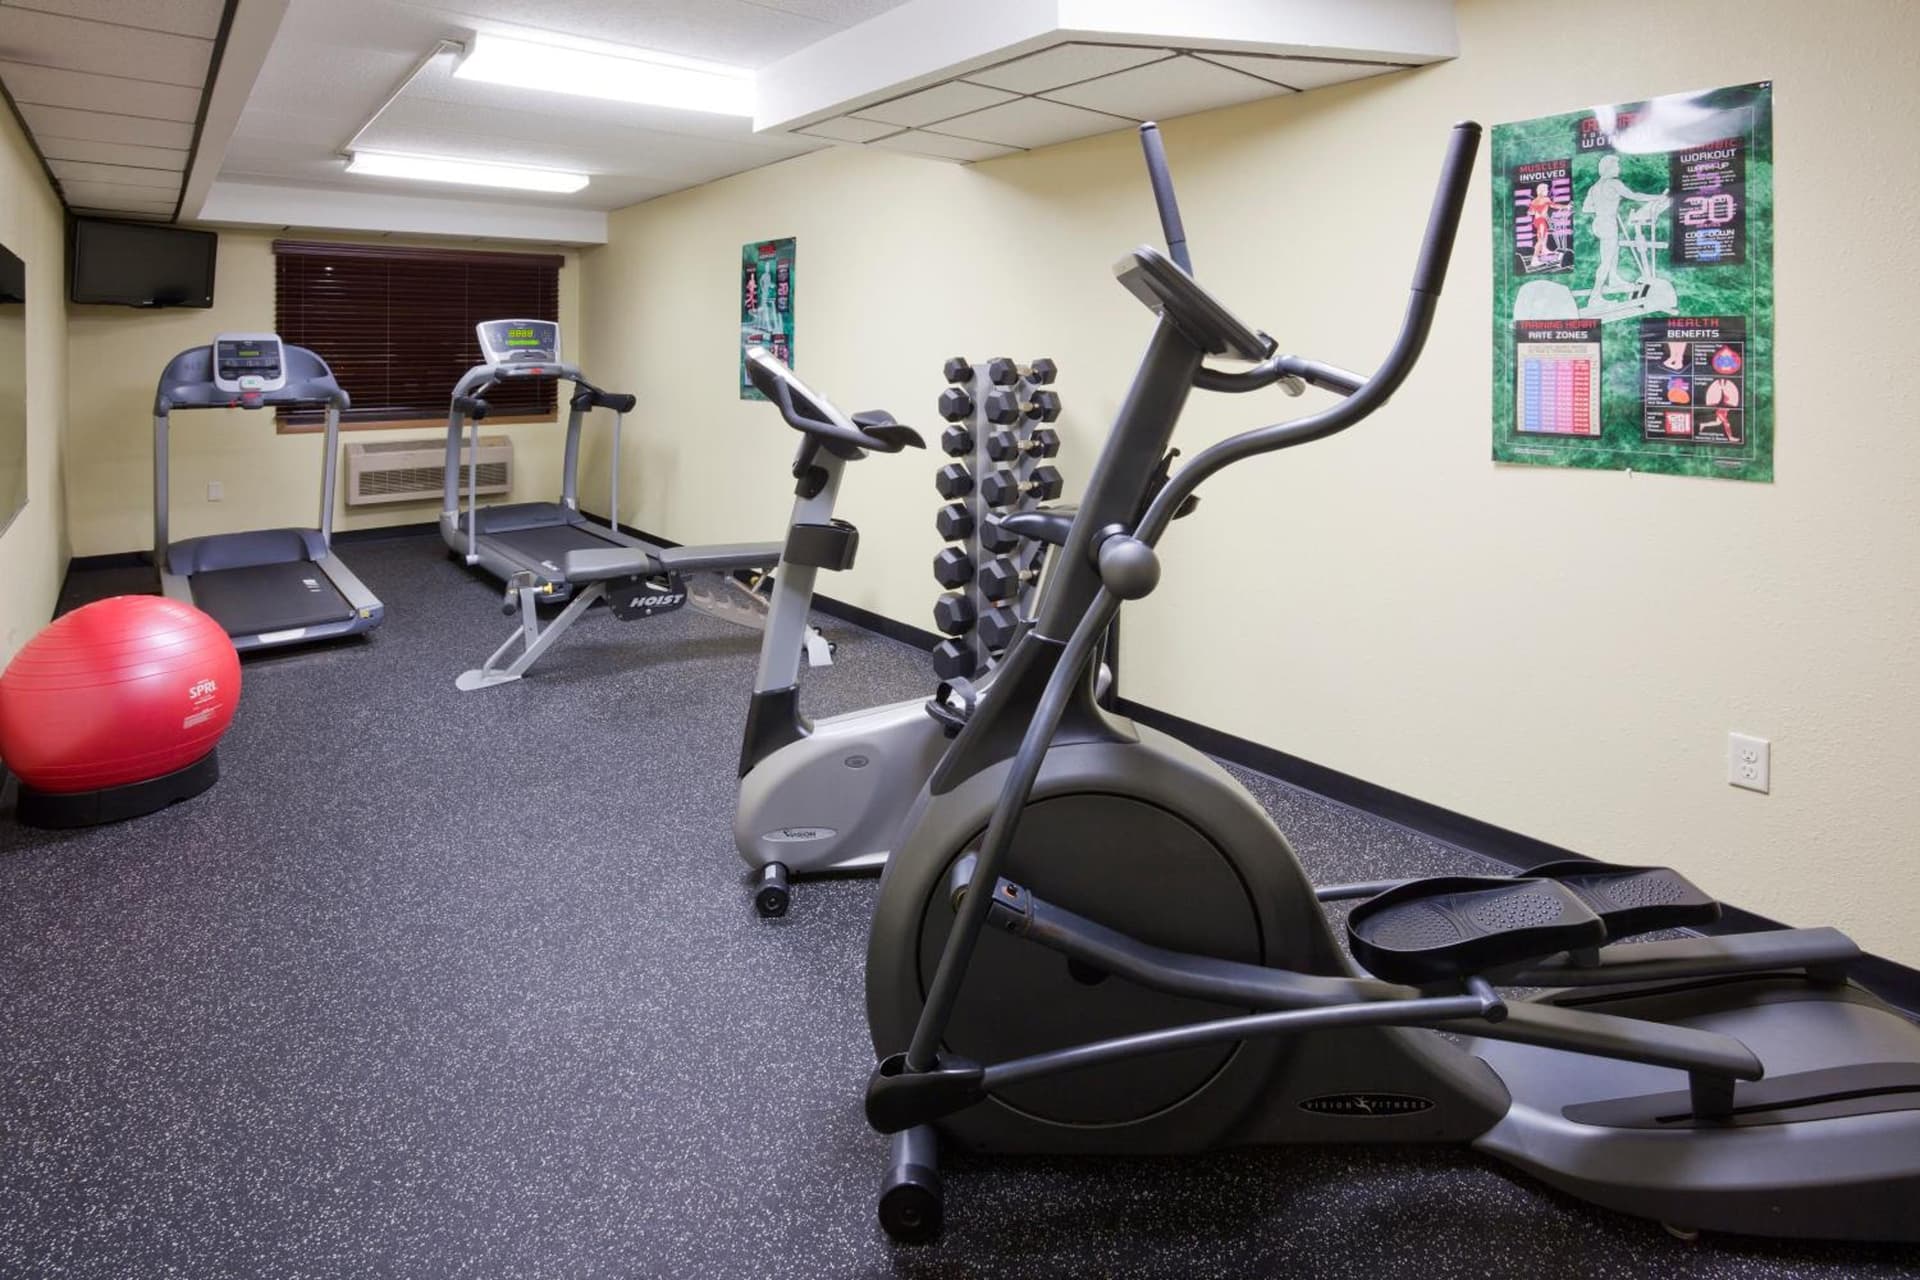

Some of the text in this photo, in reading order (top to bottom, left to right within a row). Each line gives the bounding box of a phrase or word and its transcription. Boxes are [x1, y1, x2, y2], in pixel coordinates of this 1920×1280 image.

[1680, 149, 1737, 163] WORKOUT
[1519, 160, 1567, 174] MUSCLES
[1519, 169, 1566, 181] INVOLVED
[1683, 194, 1734, 225] 20
[1667, 318, 1719, 328] HEALTH
[1528, 331, 1589, 339] RATE ZONES
[1667, 329, 1720, 338] BENEFITS
[629, 594, 684, 608] HOIST
[189, 680, 218, 699] SPRI
[1306, 1101, 1427, 1110] VISION FITNESS
